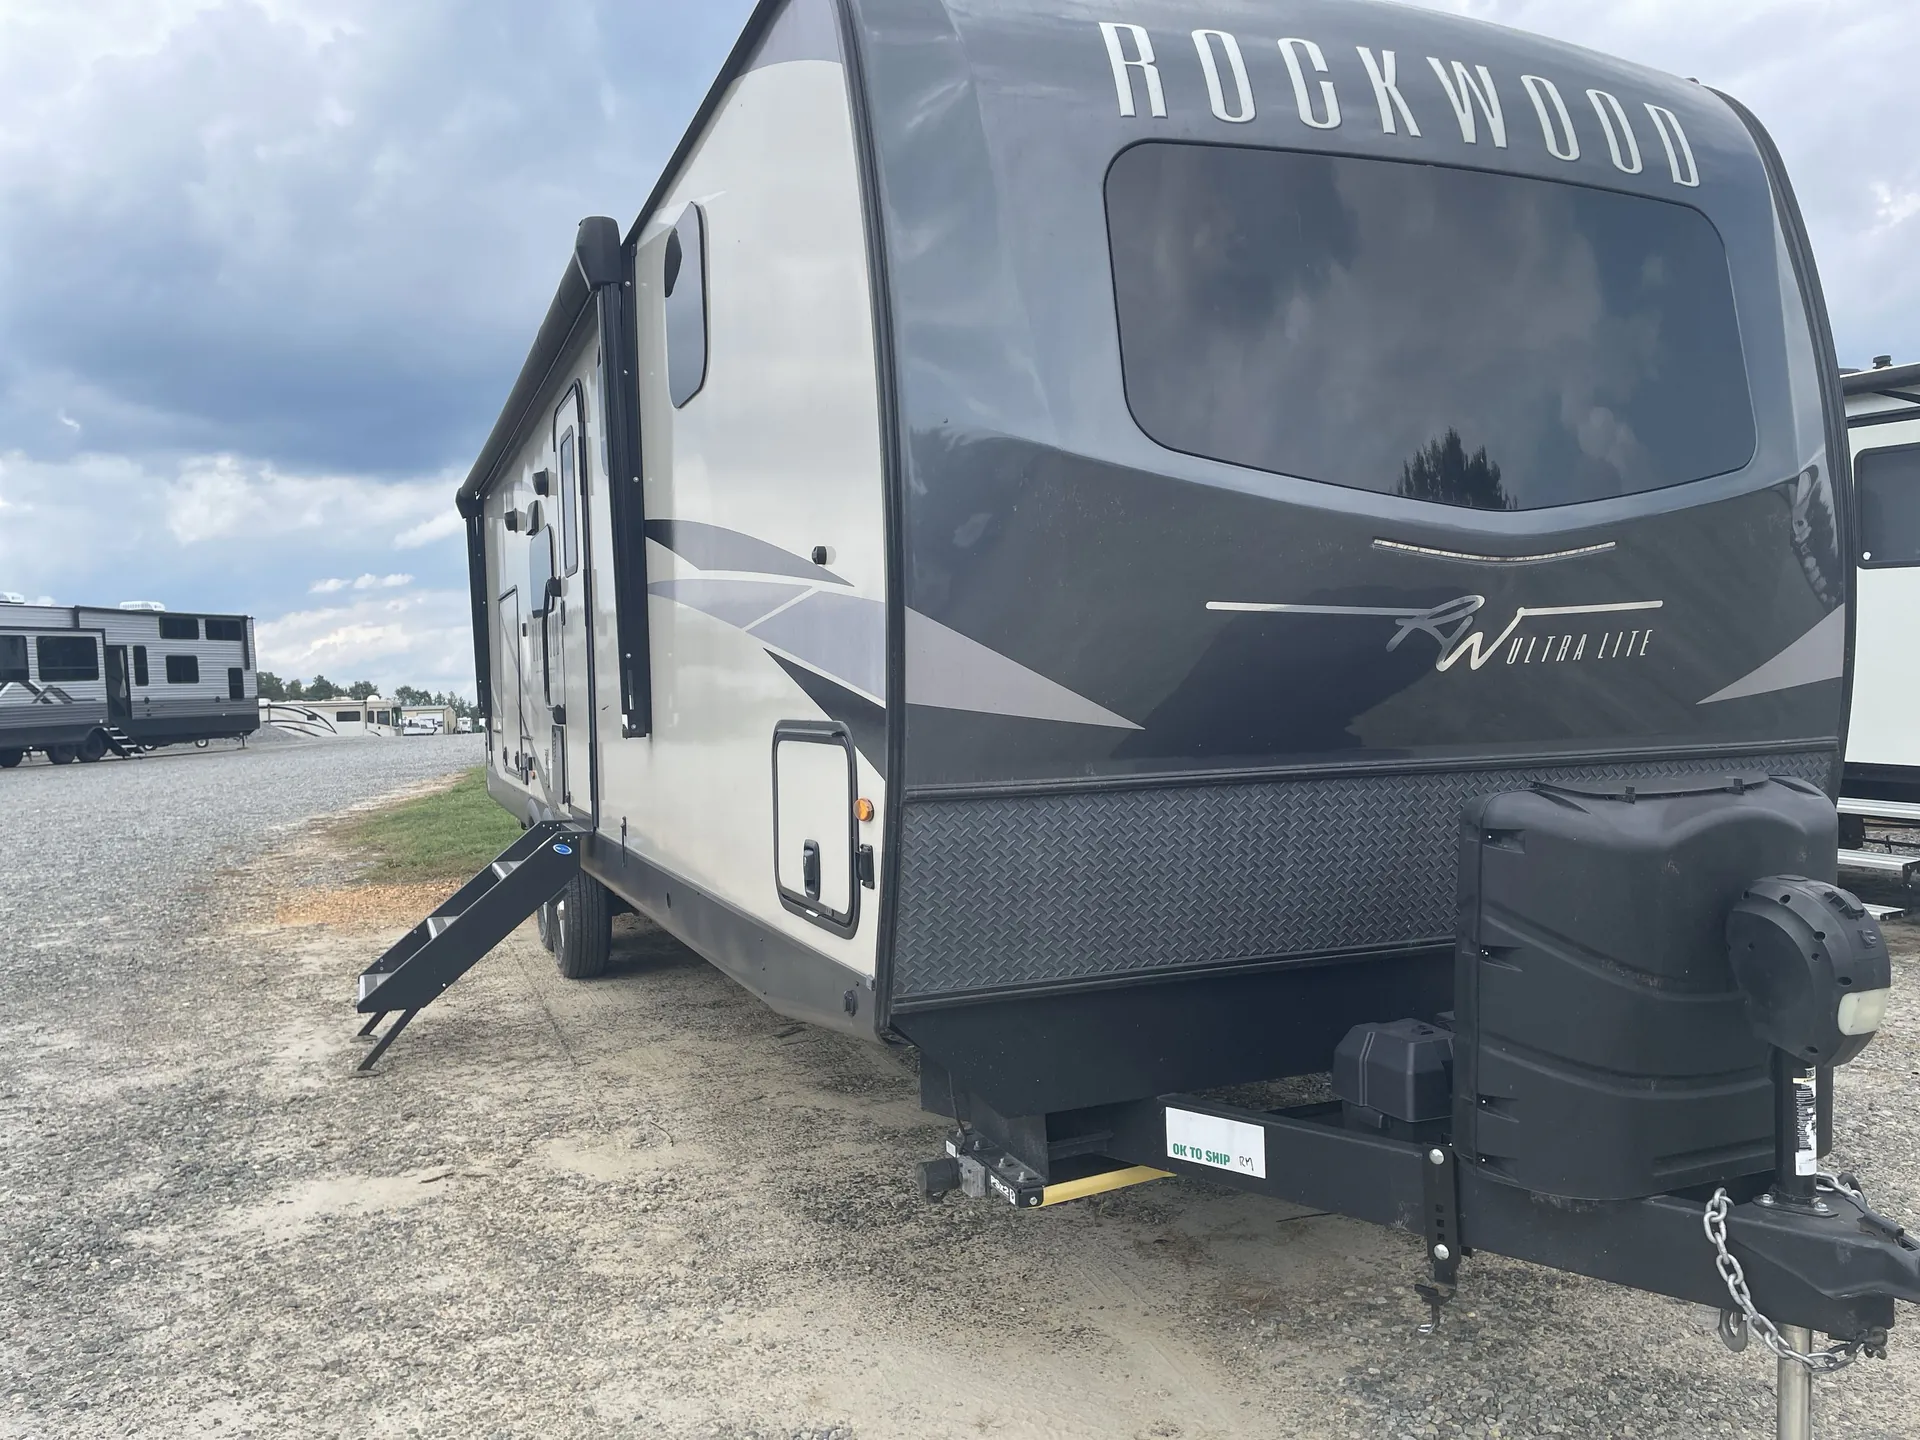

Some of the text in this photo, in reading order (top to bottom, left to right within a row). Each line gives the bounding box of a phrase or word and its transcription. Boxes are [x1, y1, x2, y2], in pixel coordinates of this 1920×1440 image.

[1099, 22, 1701, 188] ROCKWOOD
[1506, 629, 1654, 665] ULTRA LITE
[1172, 1142, 1231, 1166] OK TO SHIP
